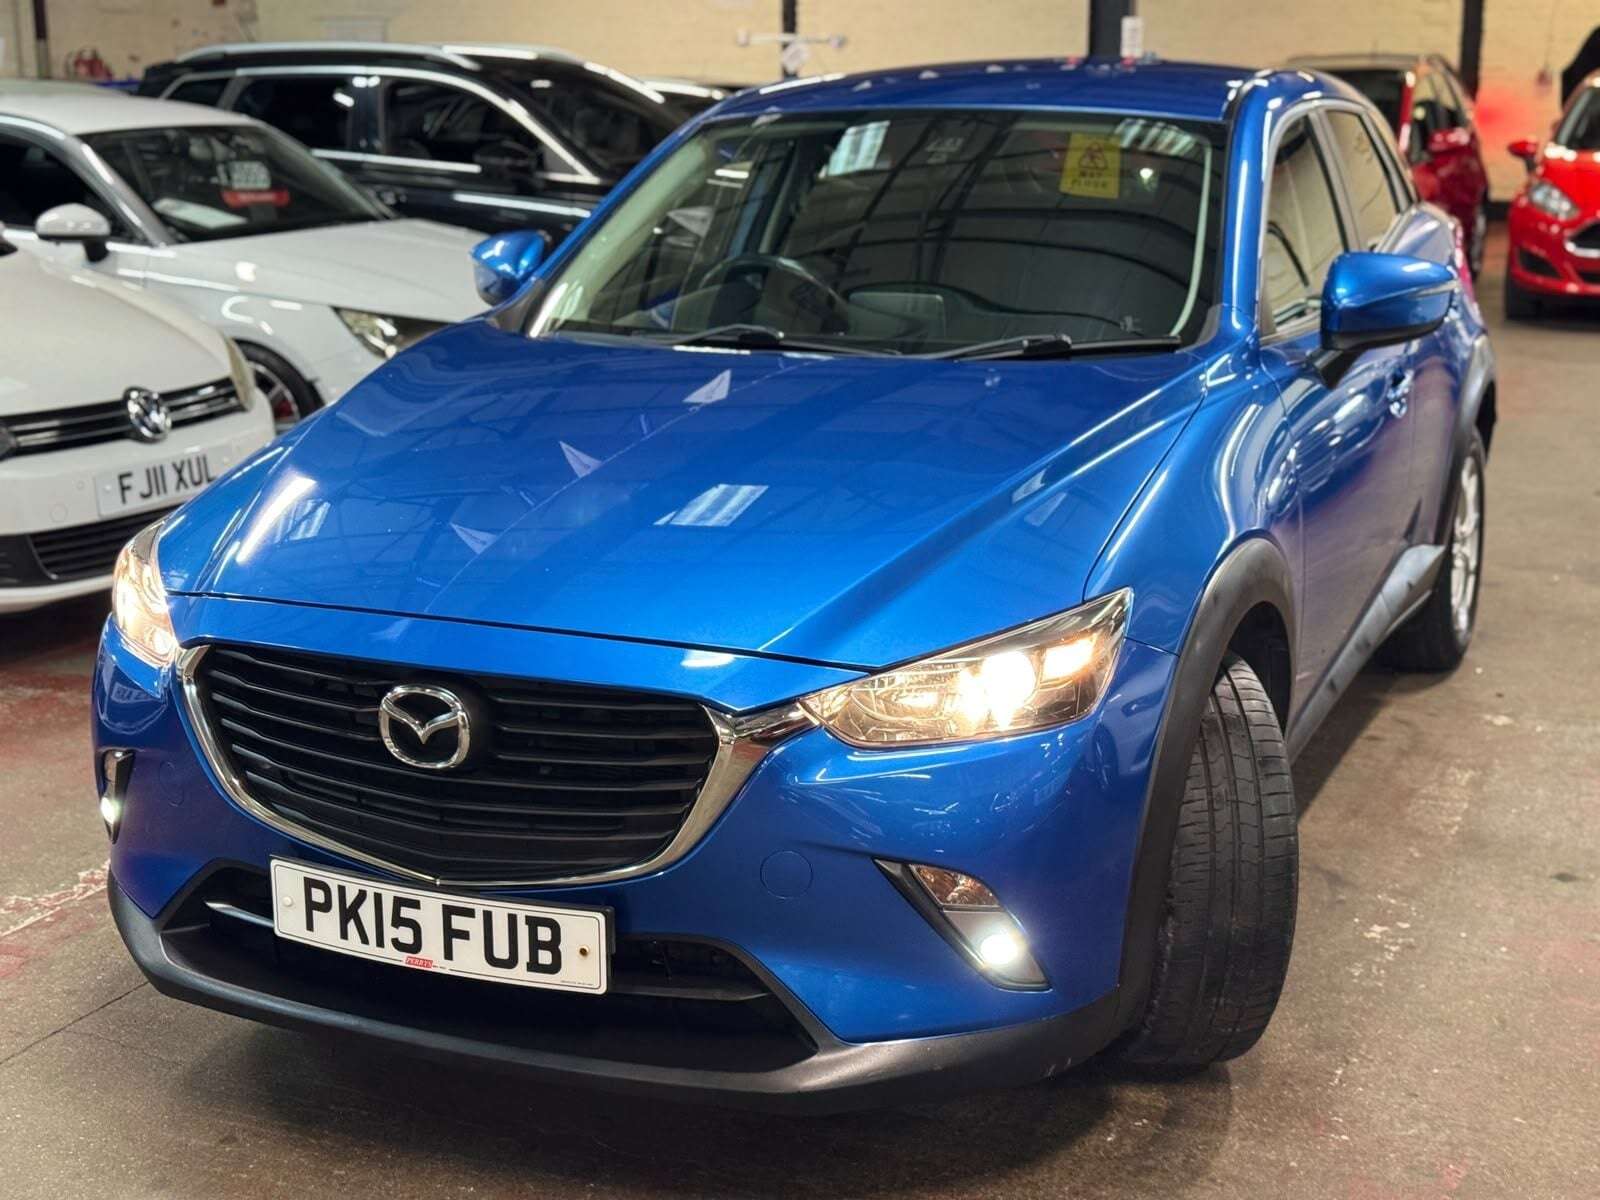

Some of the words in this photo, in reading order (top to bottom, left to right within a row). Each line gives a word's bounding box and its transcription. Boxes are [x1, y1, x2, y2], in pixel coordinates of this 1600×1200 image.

[118, 464, 168, 504] FJ11
[172, 454, 217, 492] XUL
[303, 876, 423, 954] PK15
[442, 903, 562, 975] FUB
